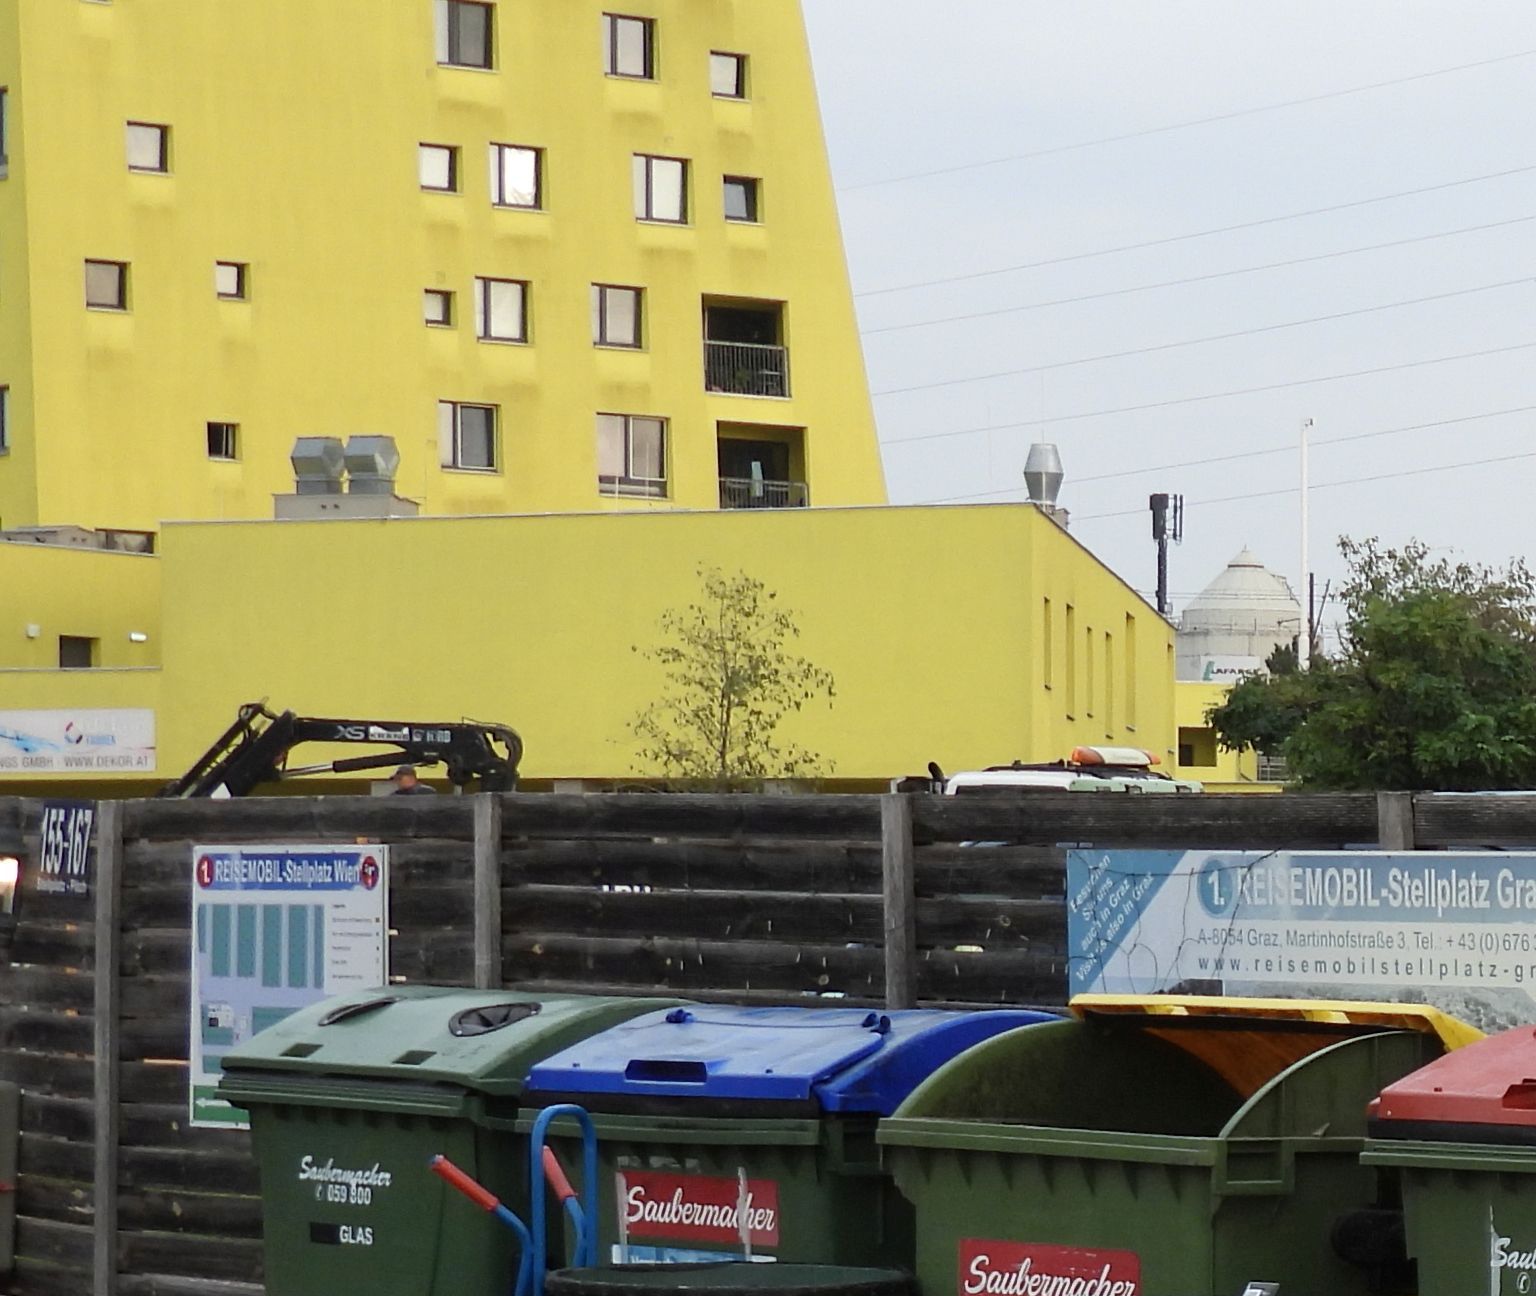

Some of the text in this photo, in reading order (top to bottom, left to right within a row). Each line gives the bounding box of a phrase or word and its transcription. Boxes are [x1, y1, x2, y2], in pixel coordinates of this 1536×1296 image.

[215, 859, 332, 888] REISEMOBIL-Stellplatz
[334, 860, 360, 883] Wien
[1109, 879, 1131, 908] Graz
[1122, 900, 1134, 915] in
[1132, 872, 1154, 901] Graz
[1236, 867, 1490, 917] REISEMOBIL-Stellplatz
[1198, 928, 1243, 946] A-8054
[1286, 929, 1394, 949] Martinhofstraße
[1479, 933, 1500, 954] (0)
[1502, 933, 1529, 952] 676
[299, 1155, 392, 1187] Saubermacher
[327, 1184, 371, 1205] 059 800
[340, 1225, 373, 1245] GLAS
